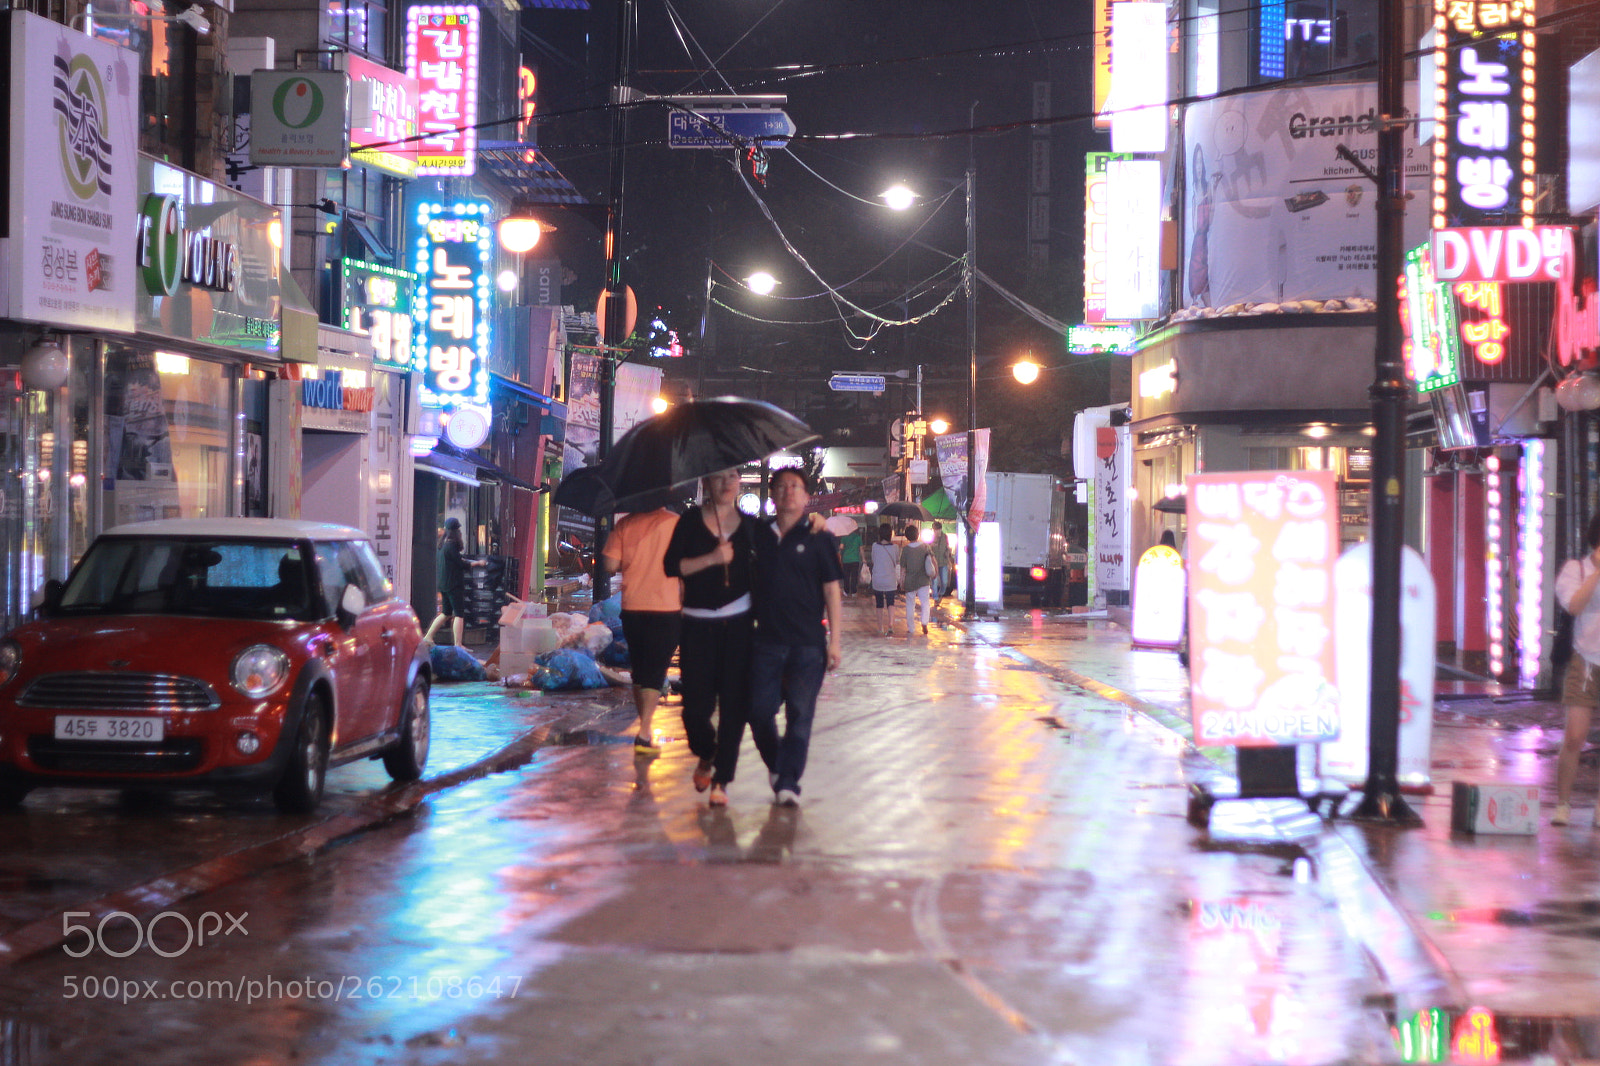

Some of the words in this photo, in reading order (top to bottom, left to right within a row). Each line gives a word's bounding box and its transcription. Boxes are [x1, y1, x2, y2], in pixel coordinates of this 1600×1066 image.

[421, 29, 464, 152] 김밥천국
[1289, 108, 1375, 139] Grand
[1457, 47, 1514, 209] 노래방
[430, 249, 476, 391] 노래방
[303, 372, 343, 410] world
[107, 720, 153, 738] 3820
